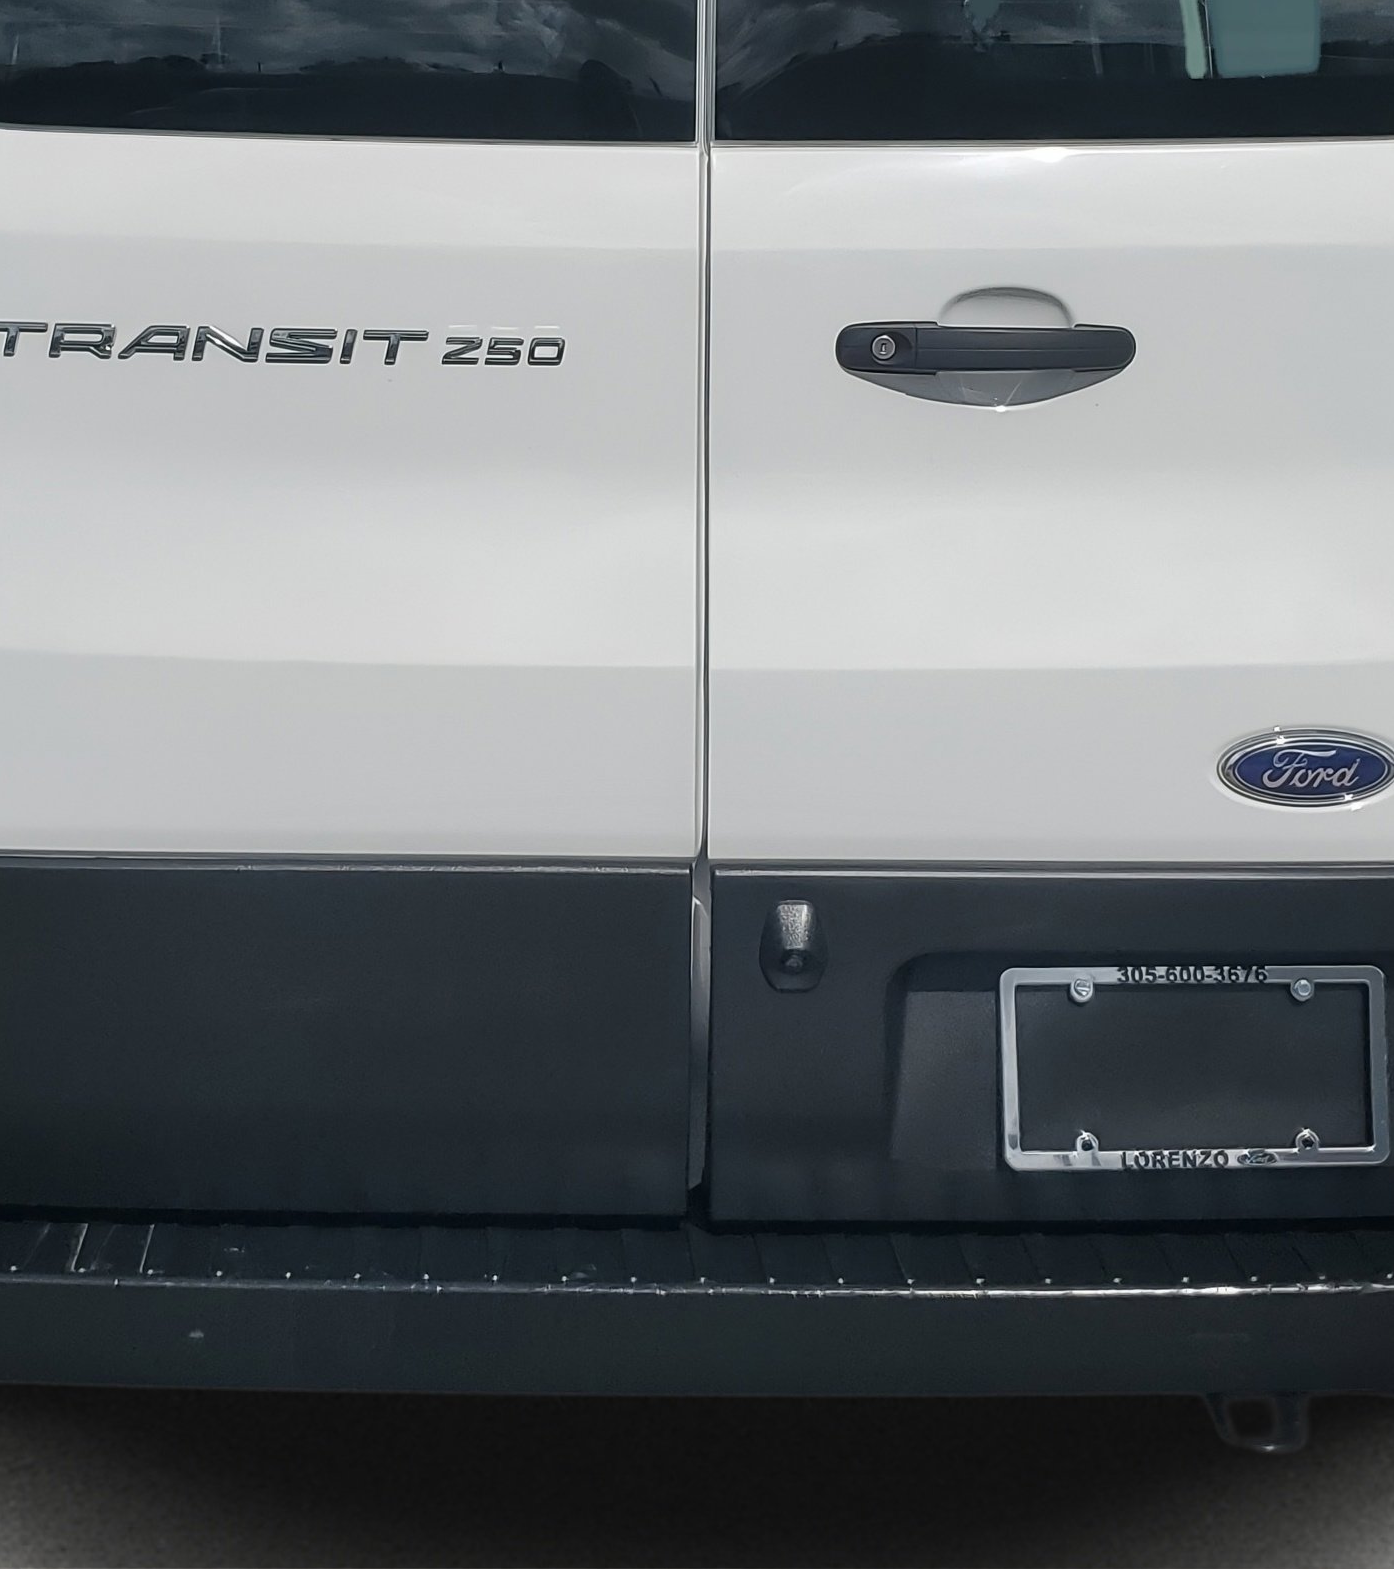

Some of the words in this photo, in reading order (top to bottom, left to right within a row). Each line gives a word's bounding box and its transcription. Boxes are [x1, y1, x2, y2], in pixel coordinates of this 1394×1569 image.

[441, 336, 566, 366] 250
[1262, 749, 1361, 788] Ford
[1116, 966, 1268, 984] 305-600-3676
[1120, 1150, 1229, 1169] LORENZO
